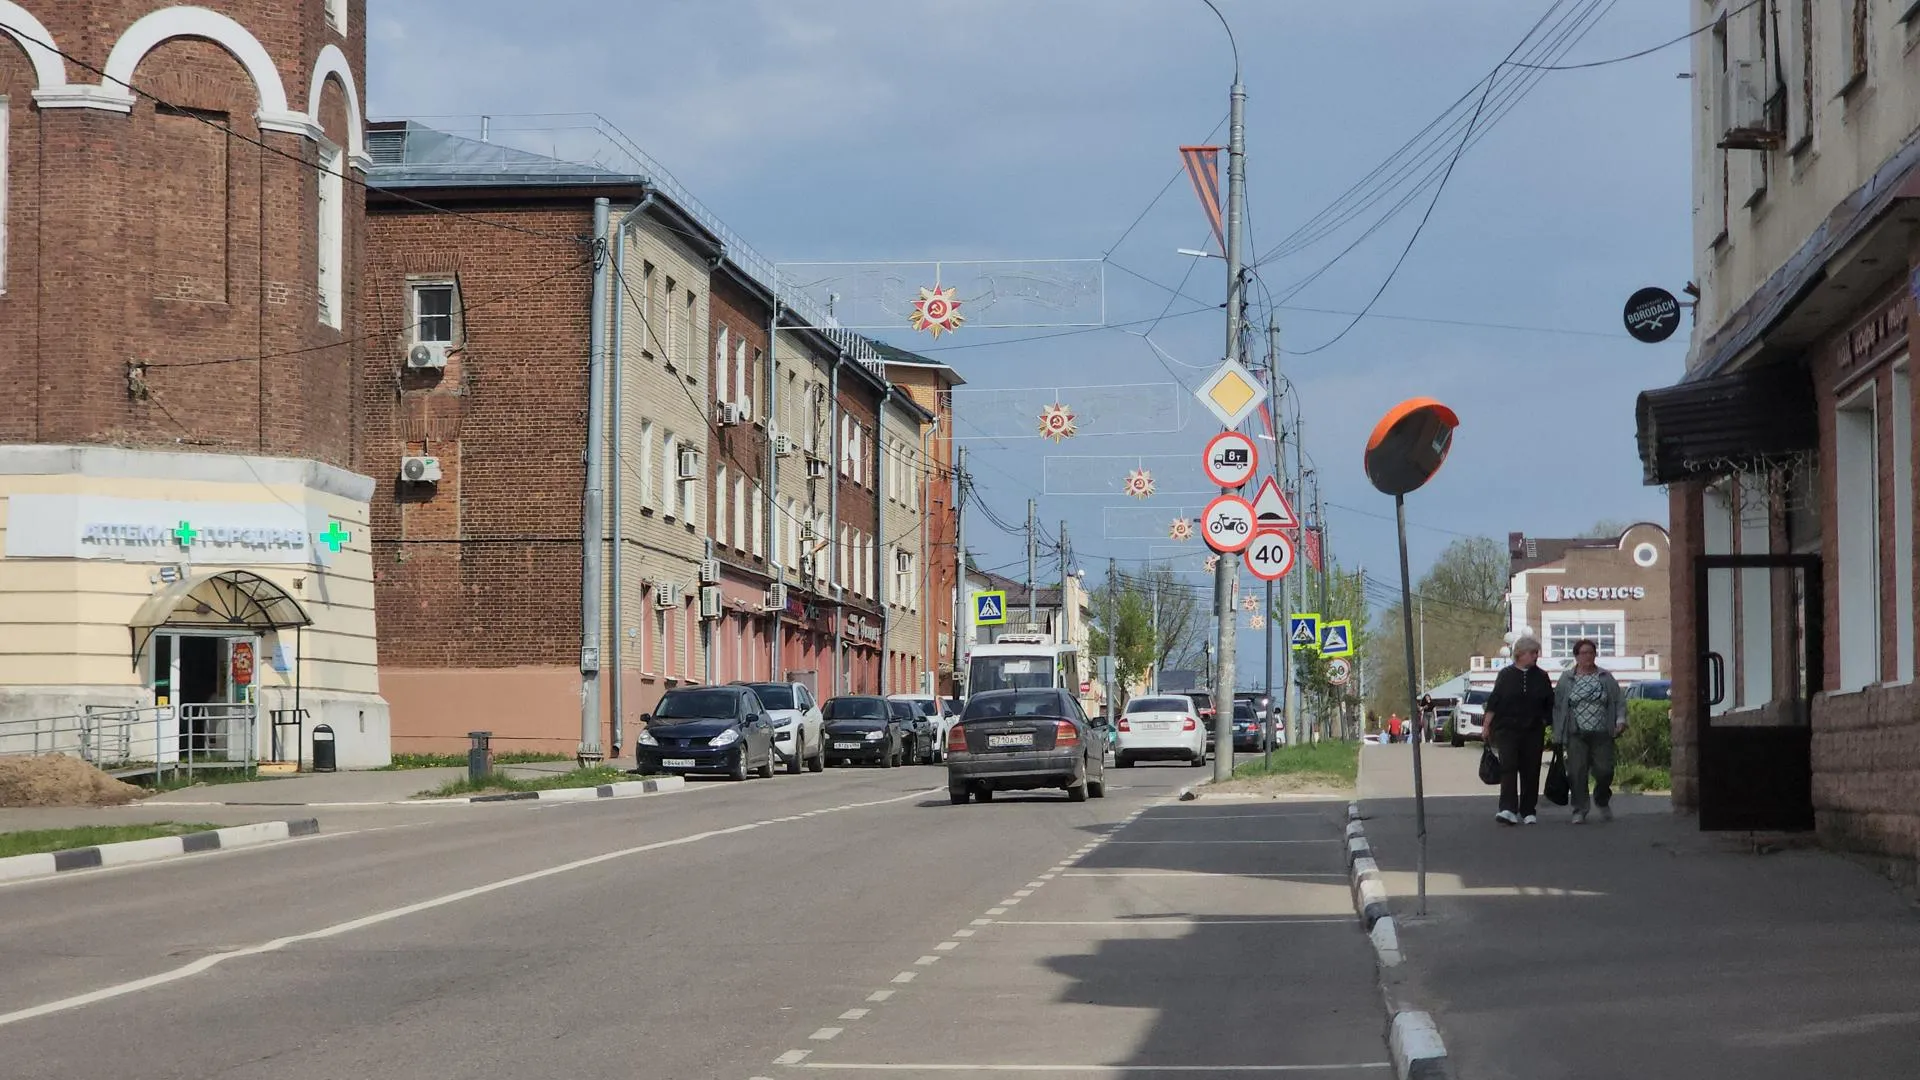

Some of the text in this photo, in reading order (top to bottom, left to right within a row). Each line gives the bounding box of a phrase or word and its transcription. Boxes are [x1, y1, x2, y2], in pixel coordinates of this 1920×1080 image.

[1627, 300, 1675, 324] BORODACH
[82, 521, 306, 549] АПТЕКИ ГОРЗДРАВ
[1255, 545, 1283, 563] 40
[1562, 586, 1644, 600] ROSTIC'S
